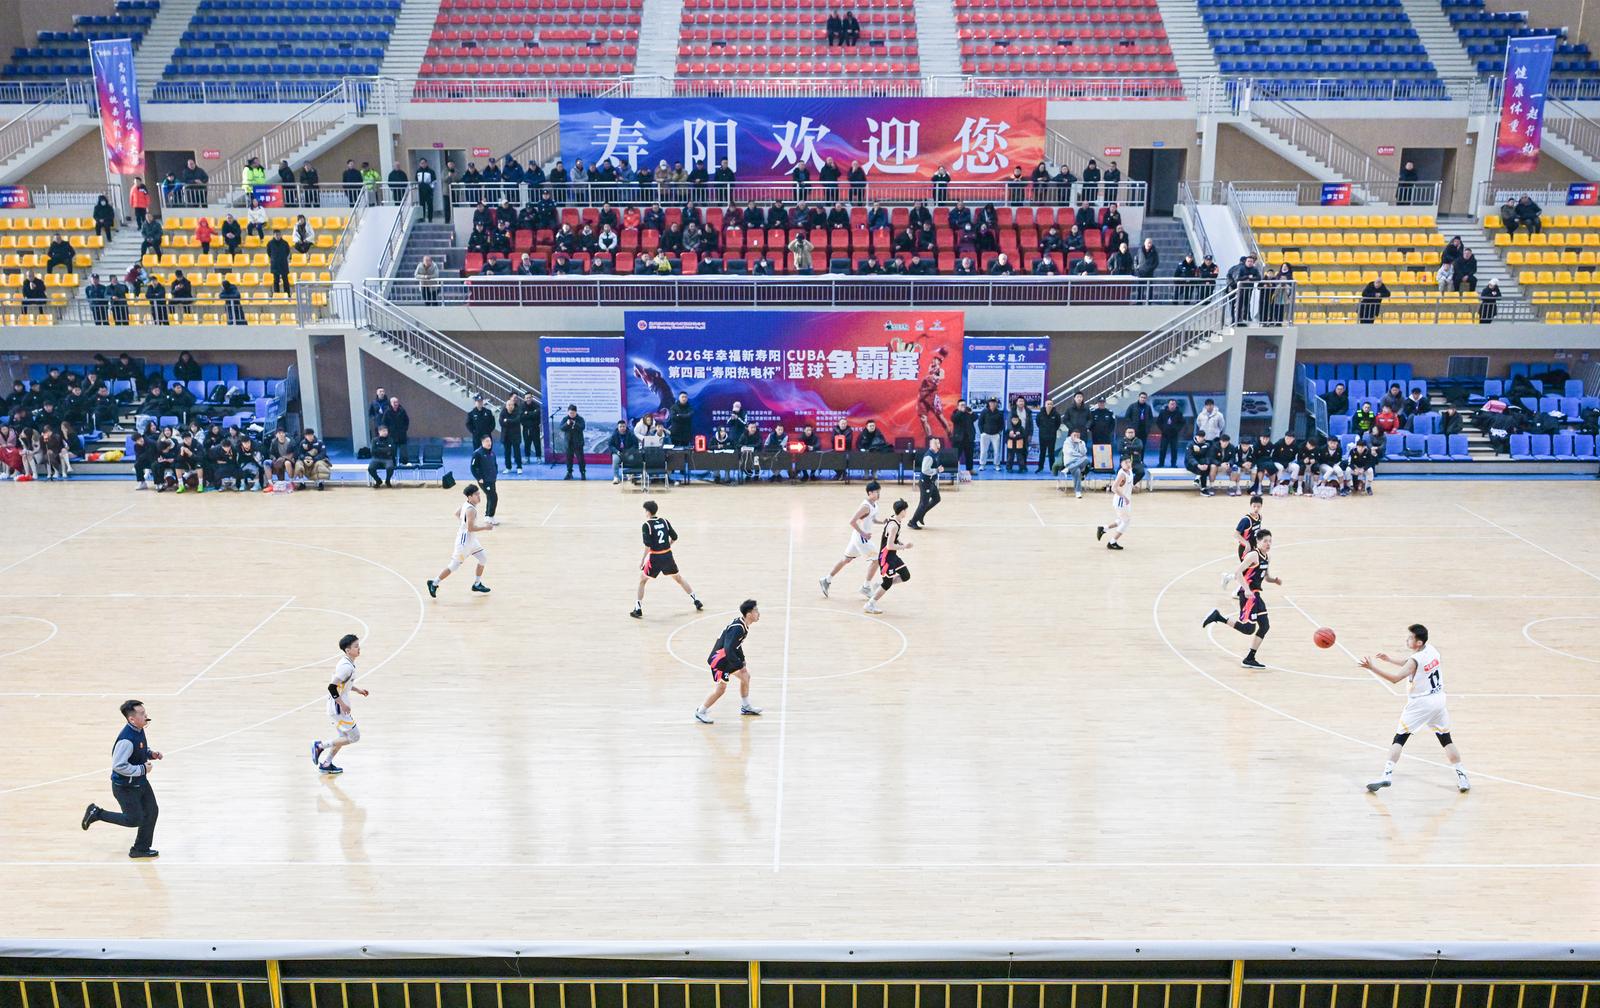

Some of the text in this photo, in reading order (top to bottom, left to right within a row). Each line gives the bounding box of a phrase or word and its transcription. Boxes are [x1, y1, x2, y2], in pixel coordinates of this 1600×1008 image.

[1508, 65, 1528, 132] 健康体重
[1521, 93, 1542, 155] 一起行动
[591, 116, 1010, 176] 寿阳欢迎您
[667, 349, 781, 362] 2026年幸福新寿阳
[786, 350, 826, 361] CUBA
[826, 346, 921, 380] 争霸赛
[668, 366, 781, 379] 第四届“寿阳热电杯”
[788, 362, 825, 379] 篮球
[657, 530, 665, 544] 2
